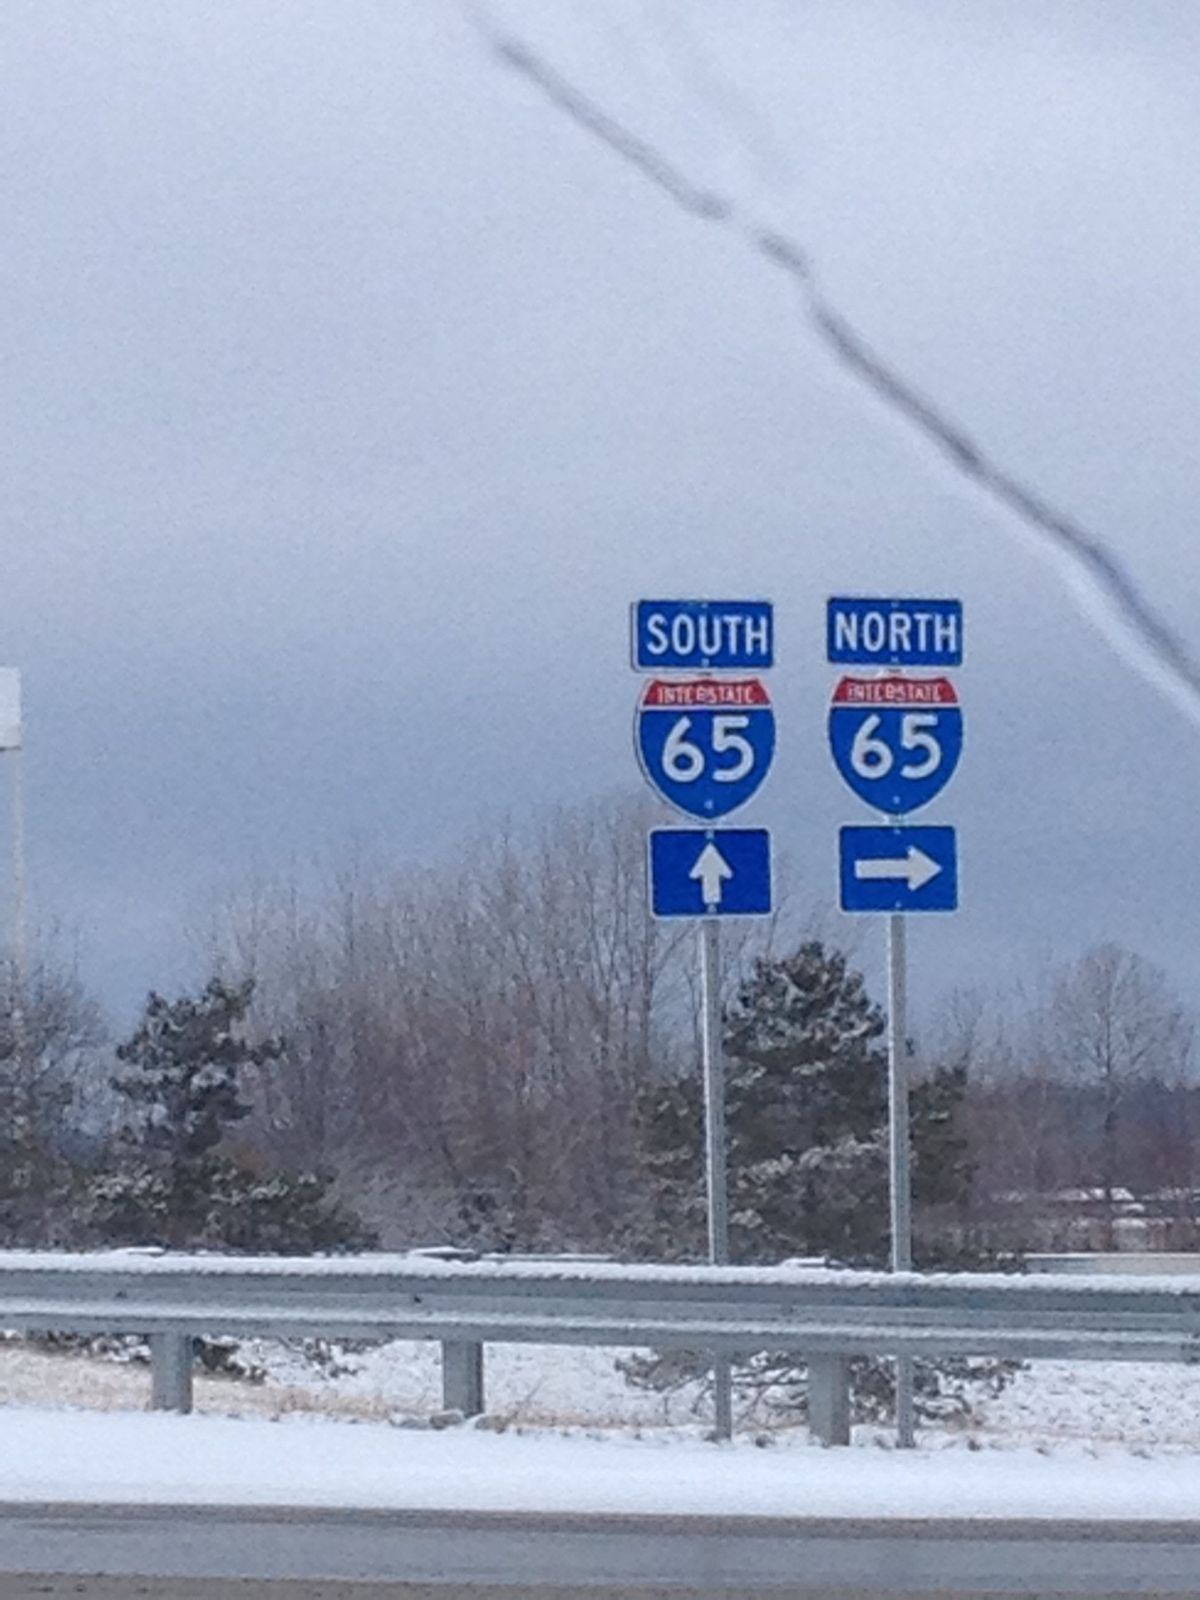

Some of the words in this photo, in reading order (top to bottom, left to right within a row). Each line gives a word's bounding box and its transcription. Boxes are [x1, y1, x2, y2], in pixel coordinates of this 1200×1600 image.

[647, 613, 769, 656] SOUTH
[834, 611, 957, 653] NORTH
[657, 685, 754, 704] INTERSTATE
[848, 683, 942, 702] INTERSTATE
[661, 714, 755, 783] 65
[850, 713, 942, 780] 65
